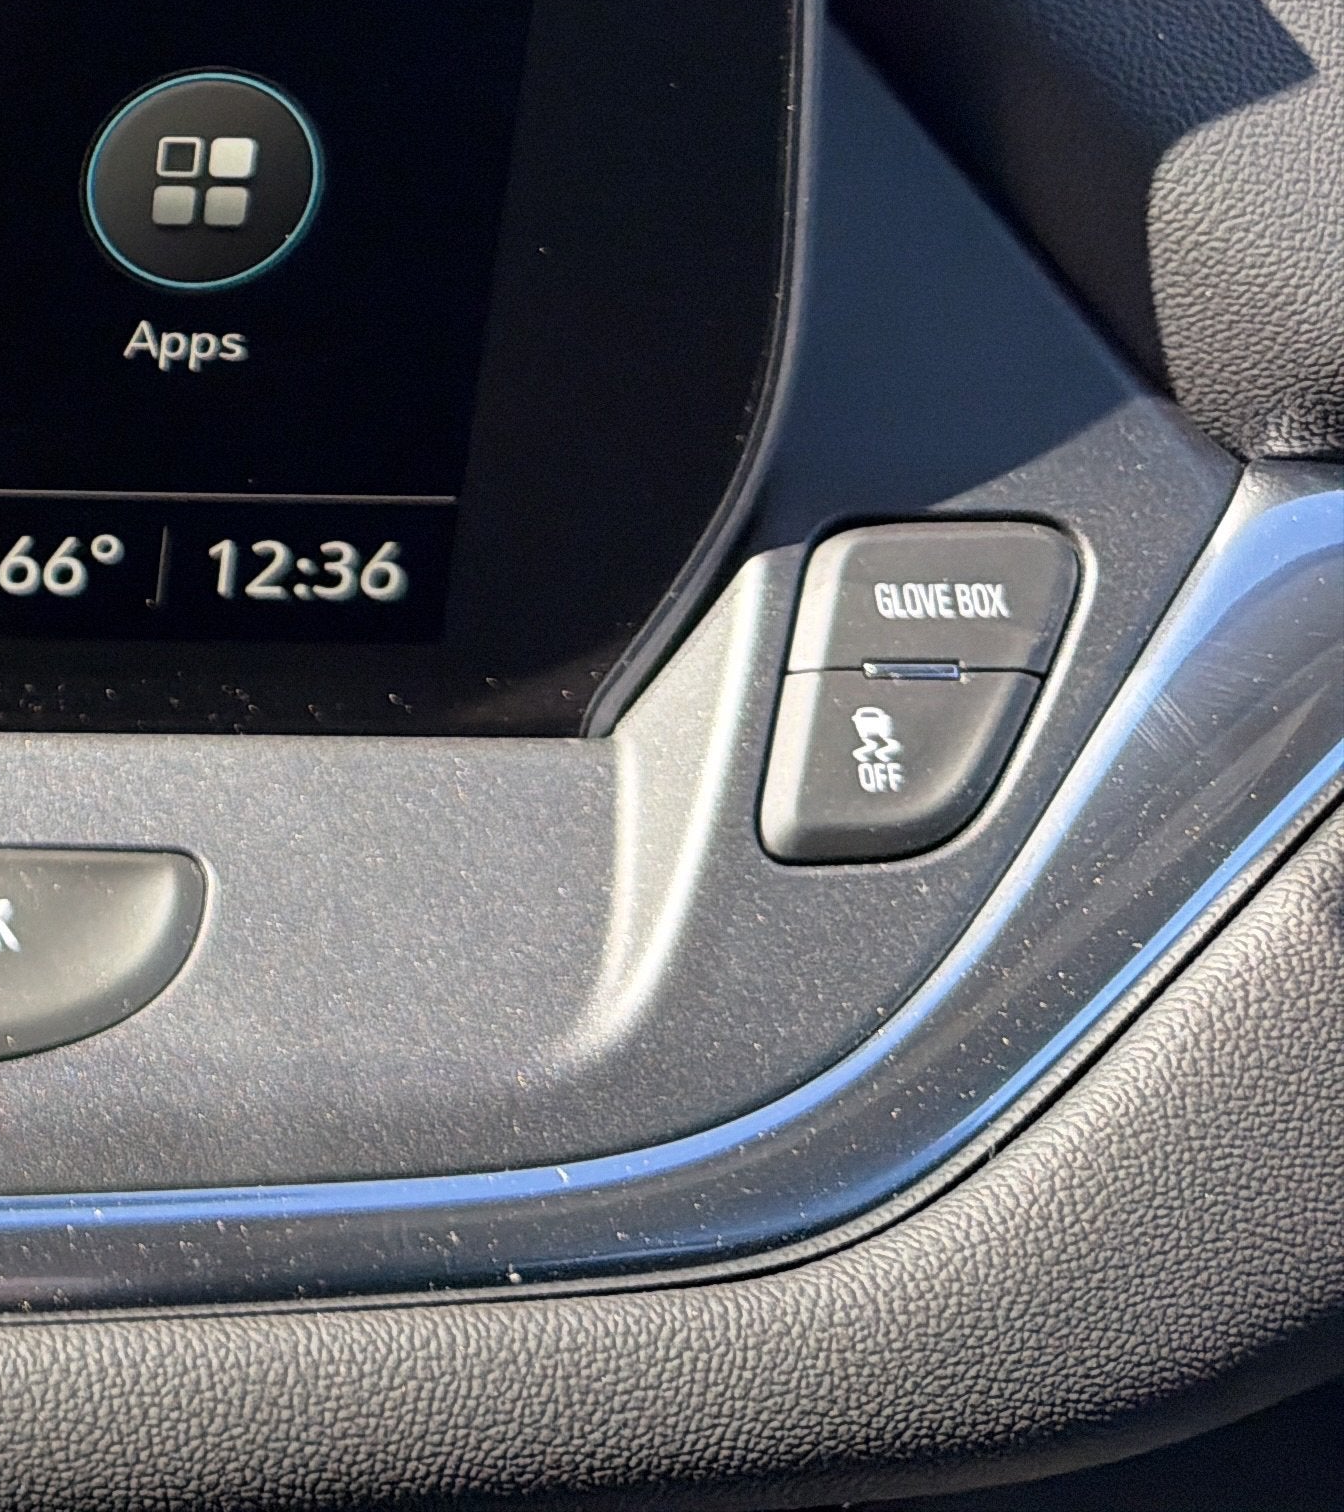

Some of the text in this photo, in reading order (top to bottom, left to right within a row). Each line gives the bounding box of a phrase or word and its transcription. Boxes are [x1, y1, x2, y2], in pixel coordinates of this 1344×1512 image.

[123, 319, 246, 372] Apps
[208, 539, 409, 602] 12:36
[874, 583, 1011, 619] GLOVE BOX
[857, 763, 906, 793] OFF
